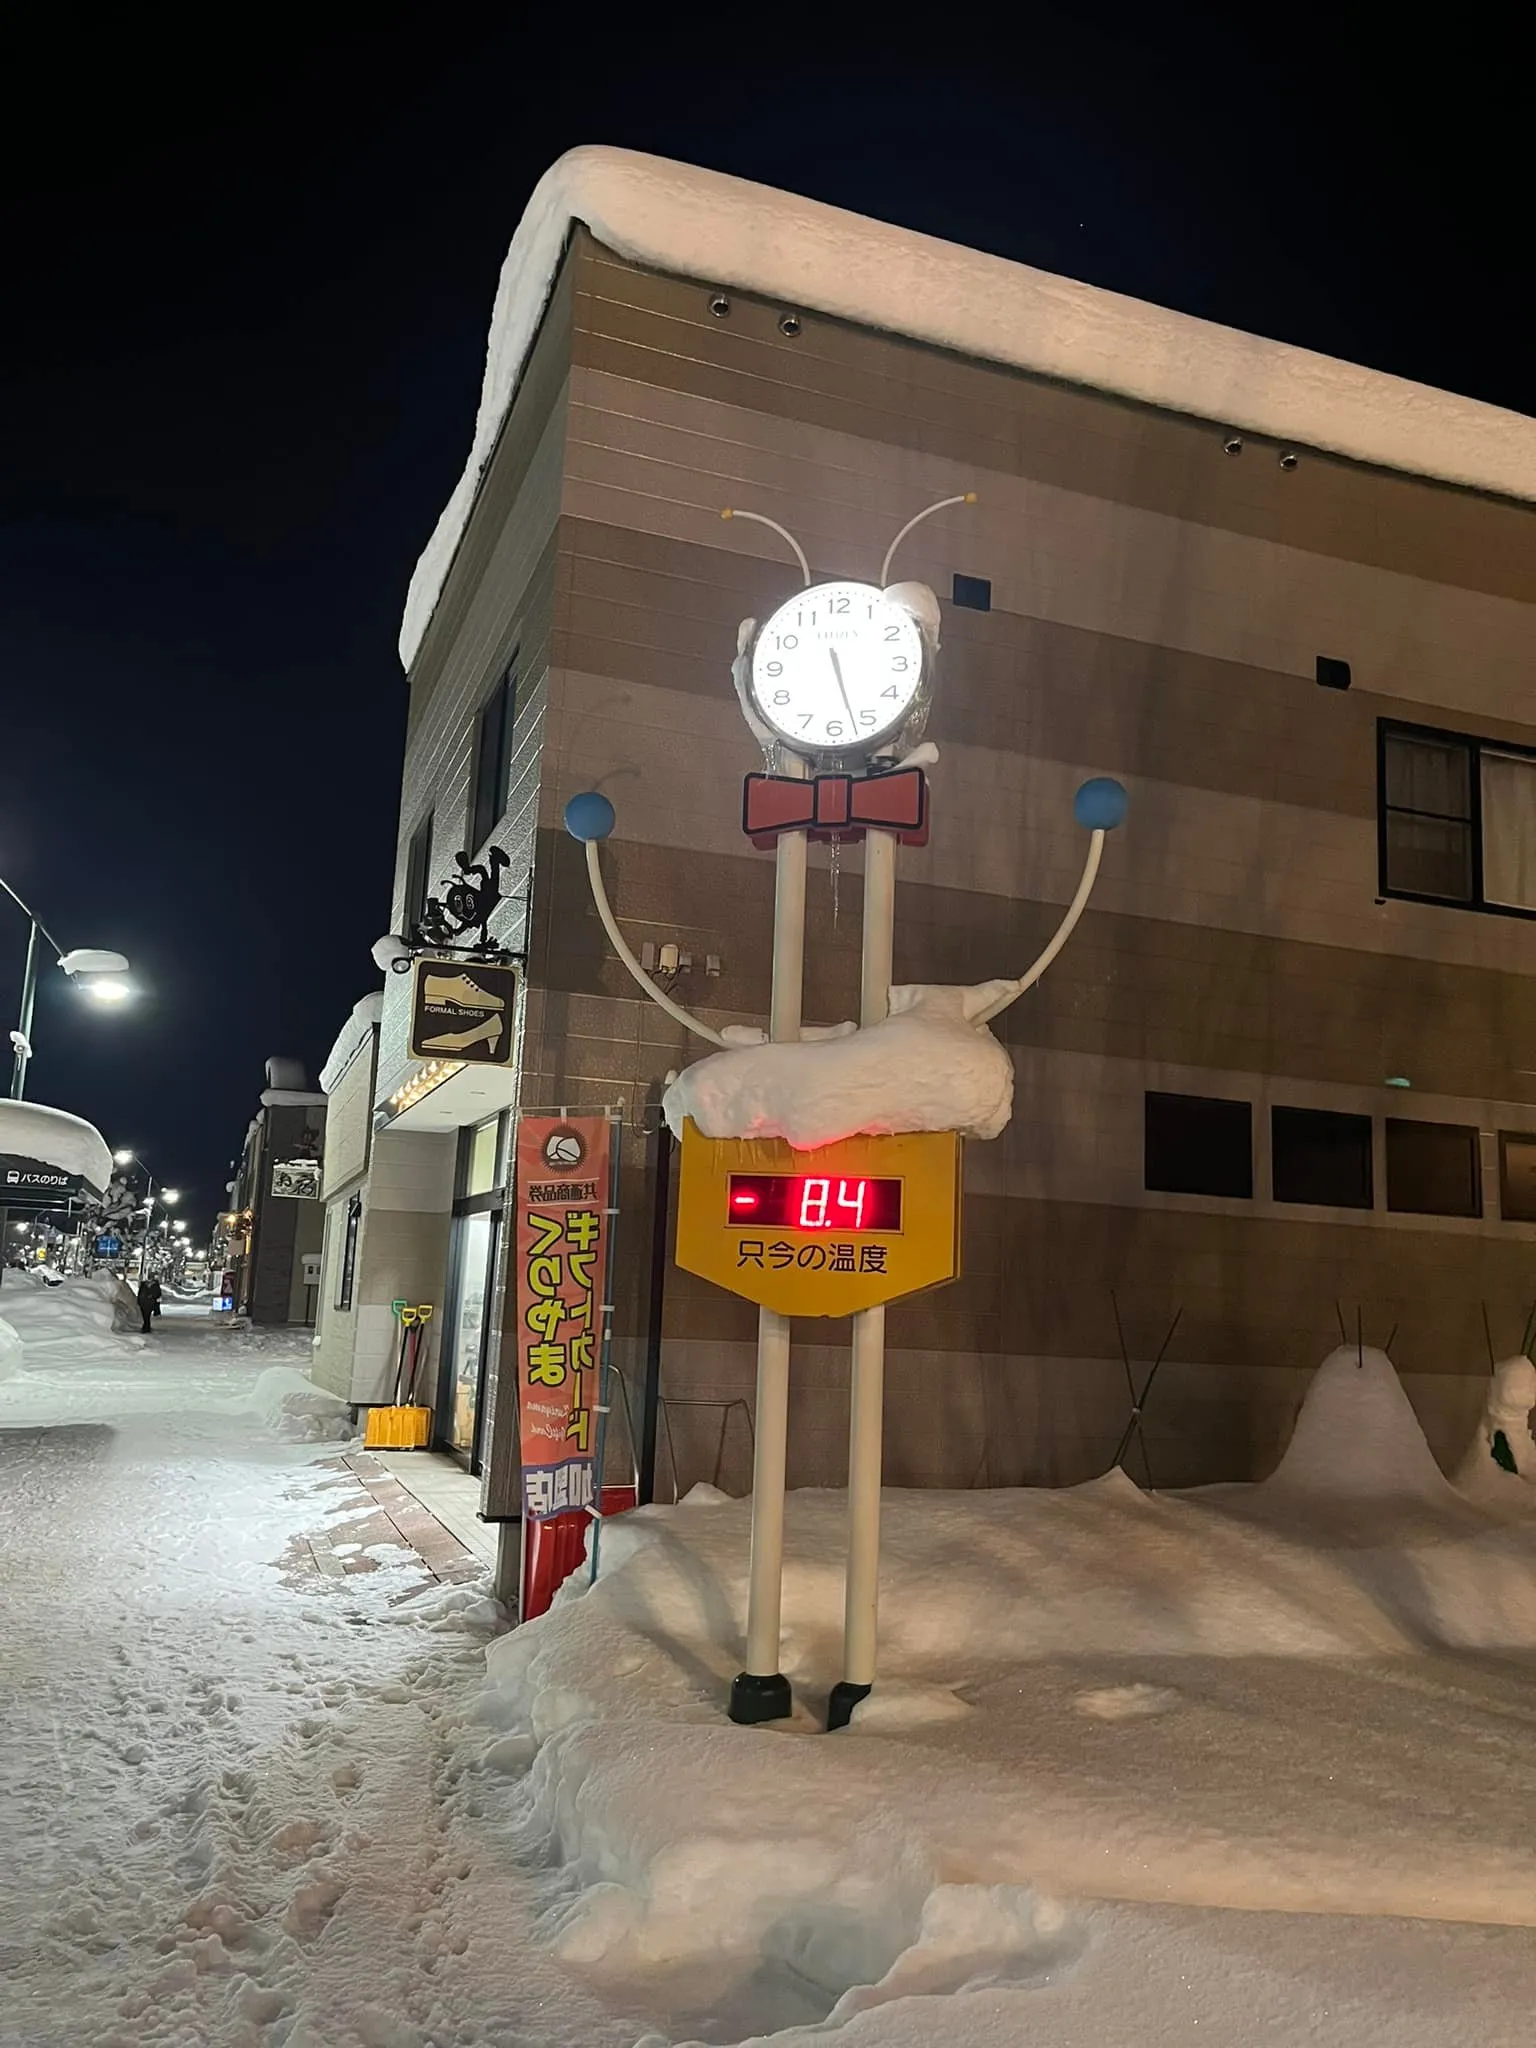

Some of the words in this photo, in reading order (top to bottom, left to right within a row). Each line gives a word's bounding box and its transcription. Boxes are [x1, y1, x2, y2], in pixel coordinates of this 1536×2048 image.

[828, 598, 850, 614] 12
[867, 604, 873, 620] 1
[797, 611, 816, 626] 11
[884, 626, 900, 641] 2
[776, 634, 798, 650] 10
[766, 661, 783, 677] 9
[891, 656, 908, 672] 3
[773, 690, 791, 705] 8
[879, 685, 899, 700] 4
[797, 714, 814, 729] 7
[859, 710, 877, 726] 5
[826, 720, 843, 736] 6
[424, 1005, 457, 1016] FORMAL
[458, 1009, 485, 1018] SHOES
[20, 1173, 69, 1186] バスのりば
[737, 1240, 888, 1274] 只今の温度
